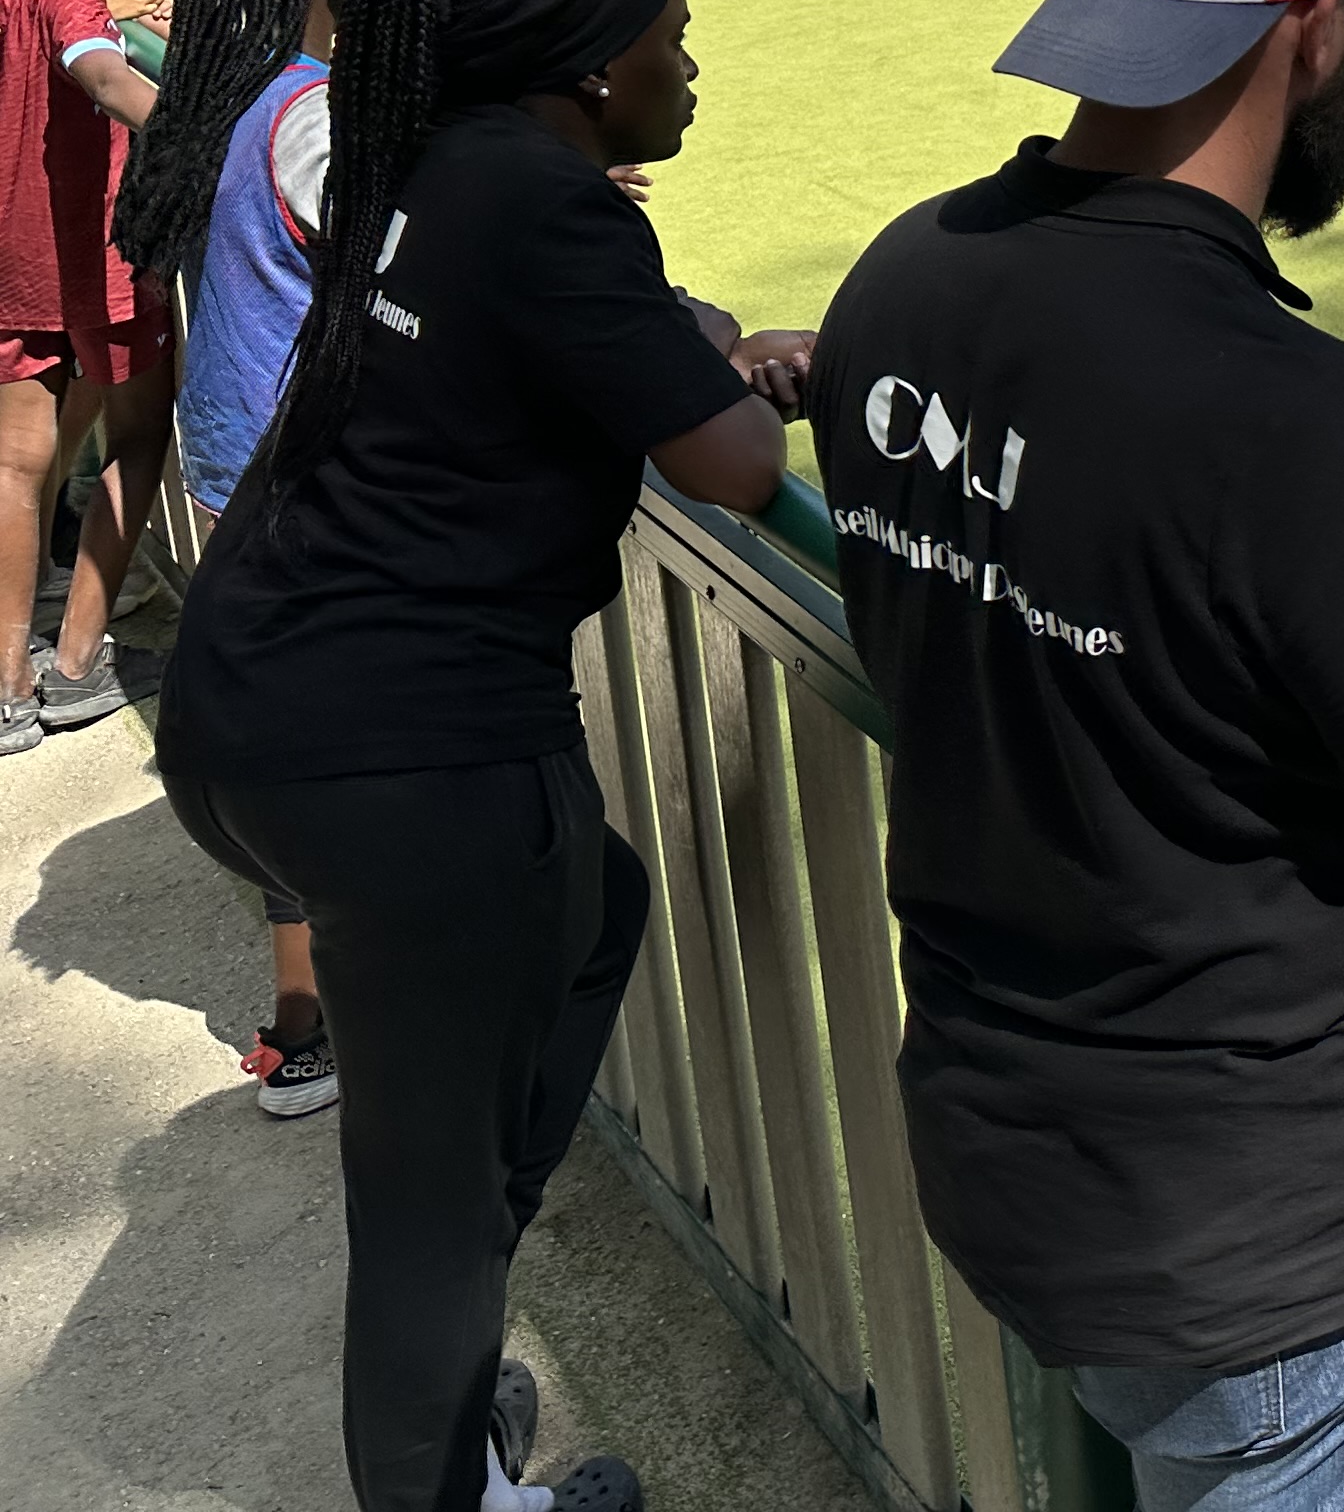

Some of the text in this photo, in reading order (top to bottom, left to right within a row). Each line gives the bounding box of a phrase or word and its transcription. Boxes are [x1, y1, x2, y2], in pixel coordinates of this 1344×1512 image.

[370, 289, 422, 340] Jeunes
[865, 375, 1026, 511] CMJ
[834, 505, 880, 543] seil
